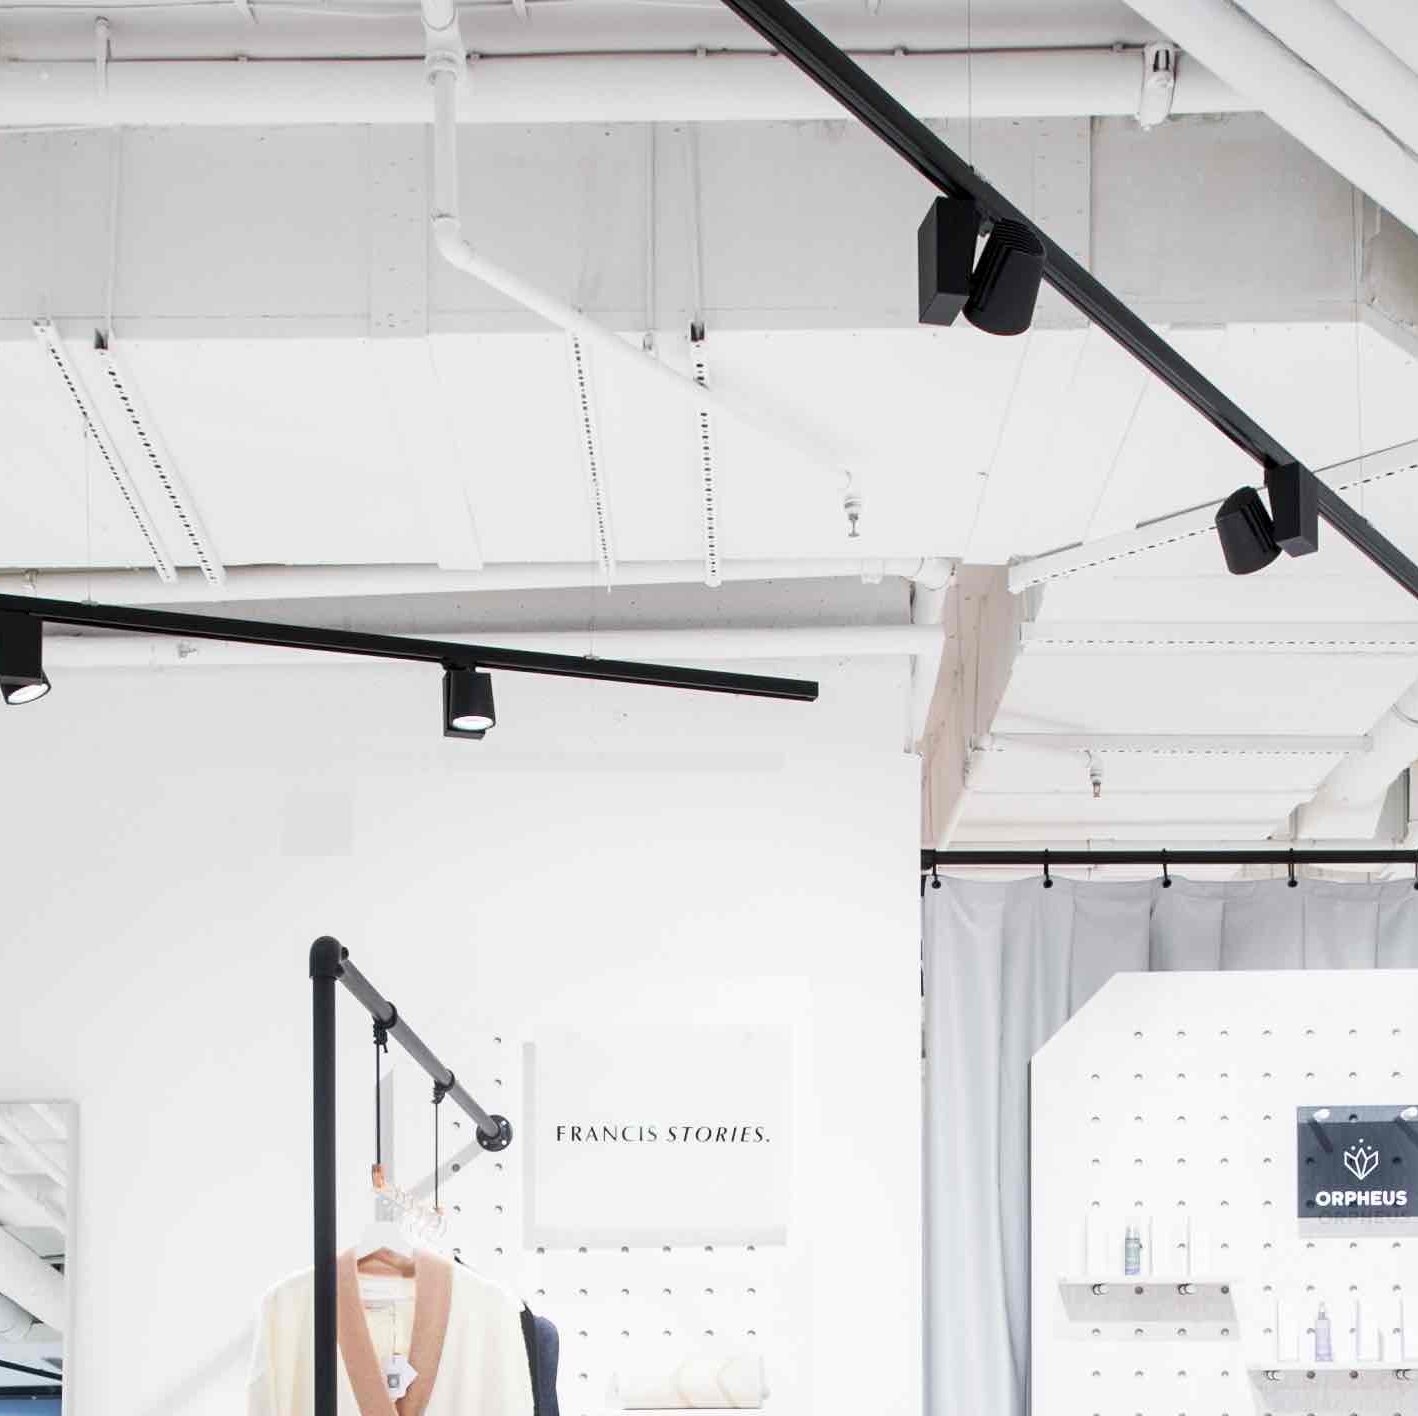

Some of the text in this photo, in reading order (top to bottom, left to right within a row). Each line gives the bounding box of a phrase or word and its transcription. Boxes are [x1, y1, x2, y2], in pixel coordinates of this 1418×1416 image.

[556, 1125, 771, 1143] FRANCIS STORIES.
[1315, 1190, 1408, 1206] ORPHEUS
